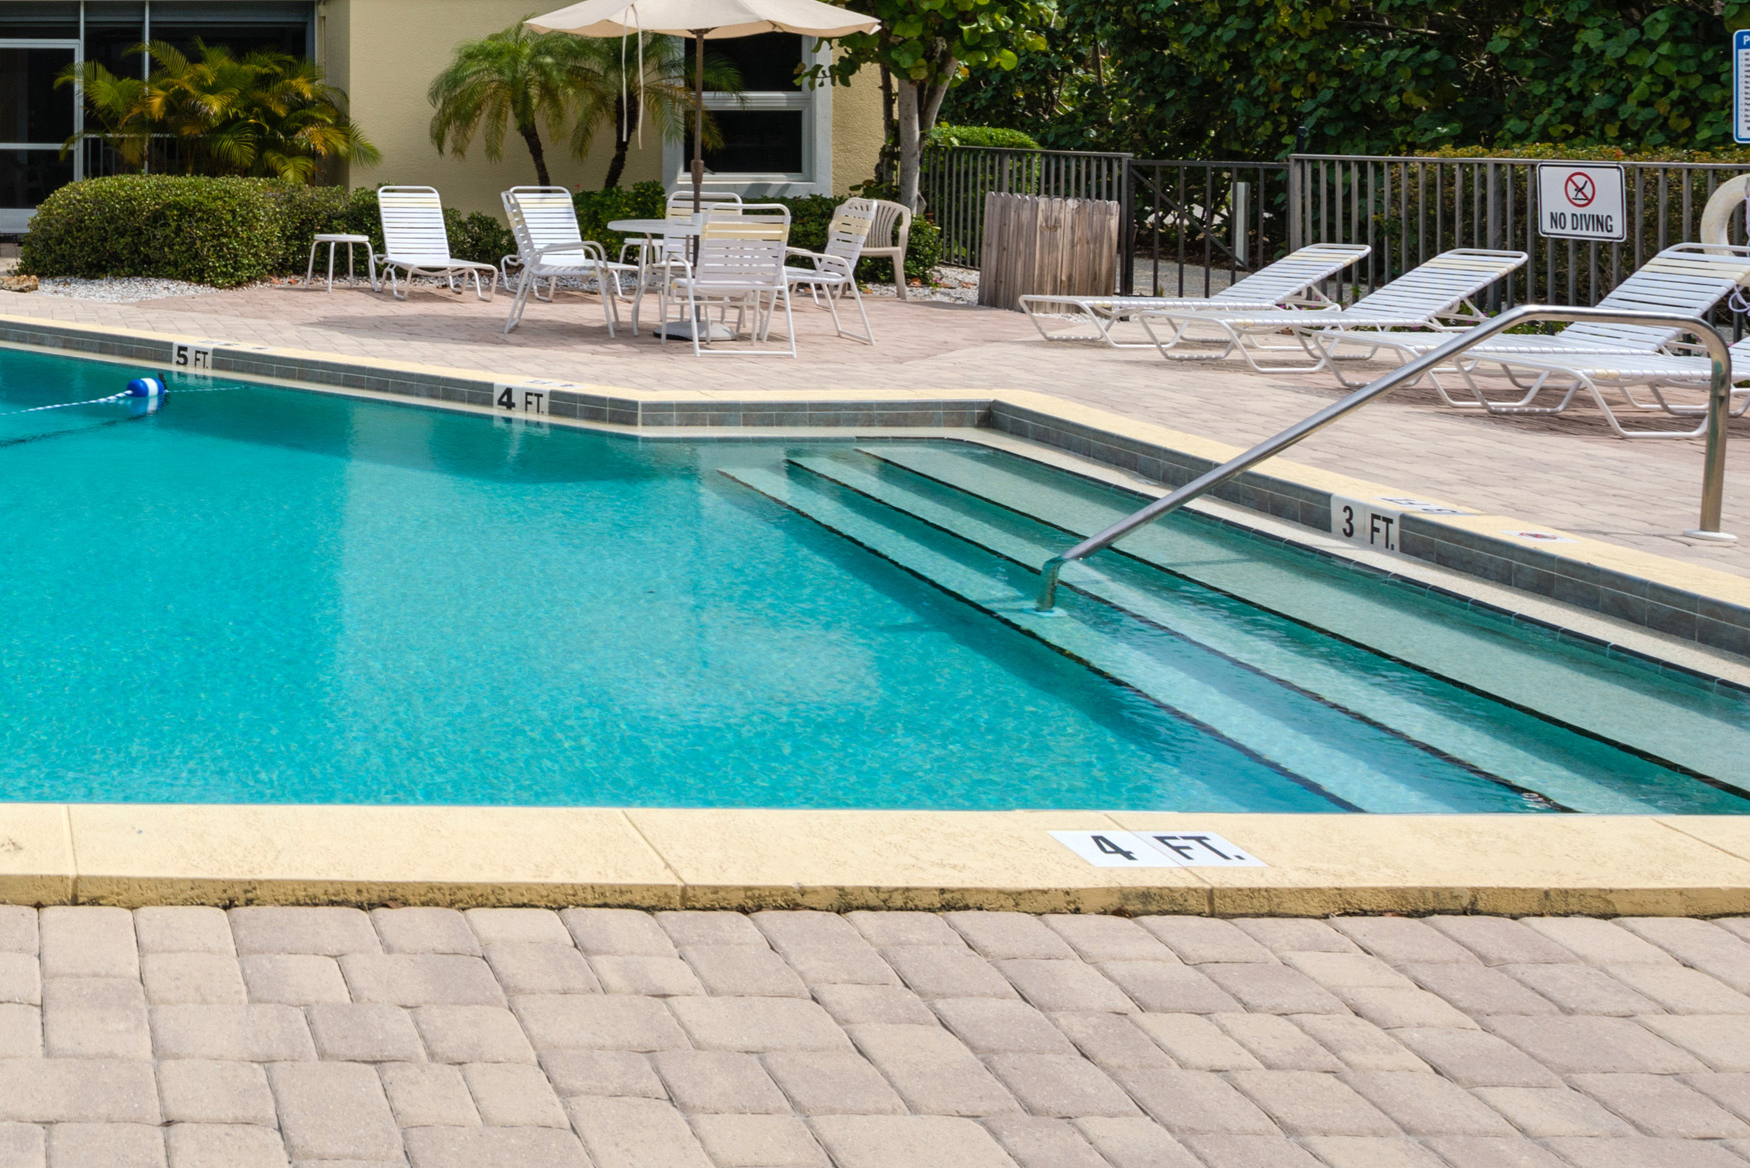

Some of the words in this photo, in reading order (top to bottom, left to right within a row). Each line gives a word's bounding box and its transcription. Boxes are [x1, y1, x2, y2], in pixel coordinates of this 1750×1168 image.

[1743, 35, 1750, 45] P
[1550, 212, 1567, 230] NO
[1571, 213, 1614, 233] DIVING
[176, 345, 188, 365] 5
[497, 387, 516, 410] 4
[525, 392, 544, 414] FT.
[1342, 505, 1354, 538] 3
[1370, 513, 1394, 551] FT.
[1090, 835, 1138, 861] 4
[1152, 835, 1246, 861] FT.
